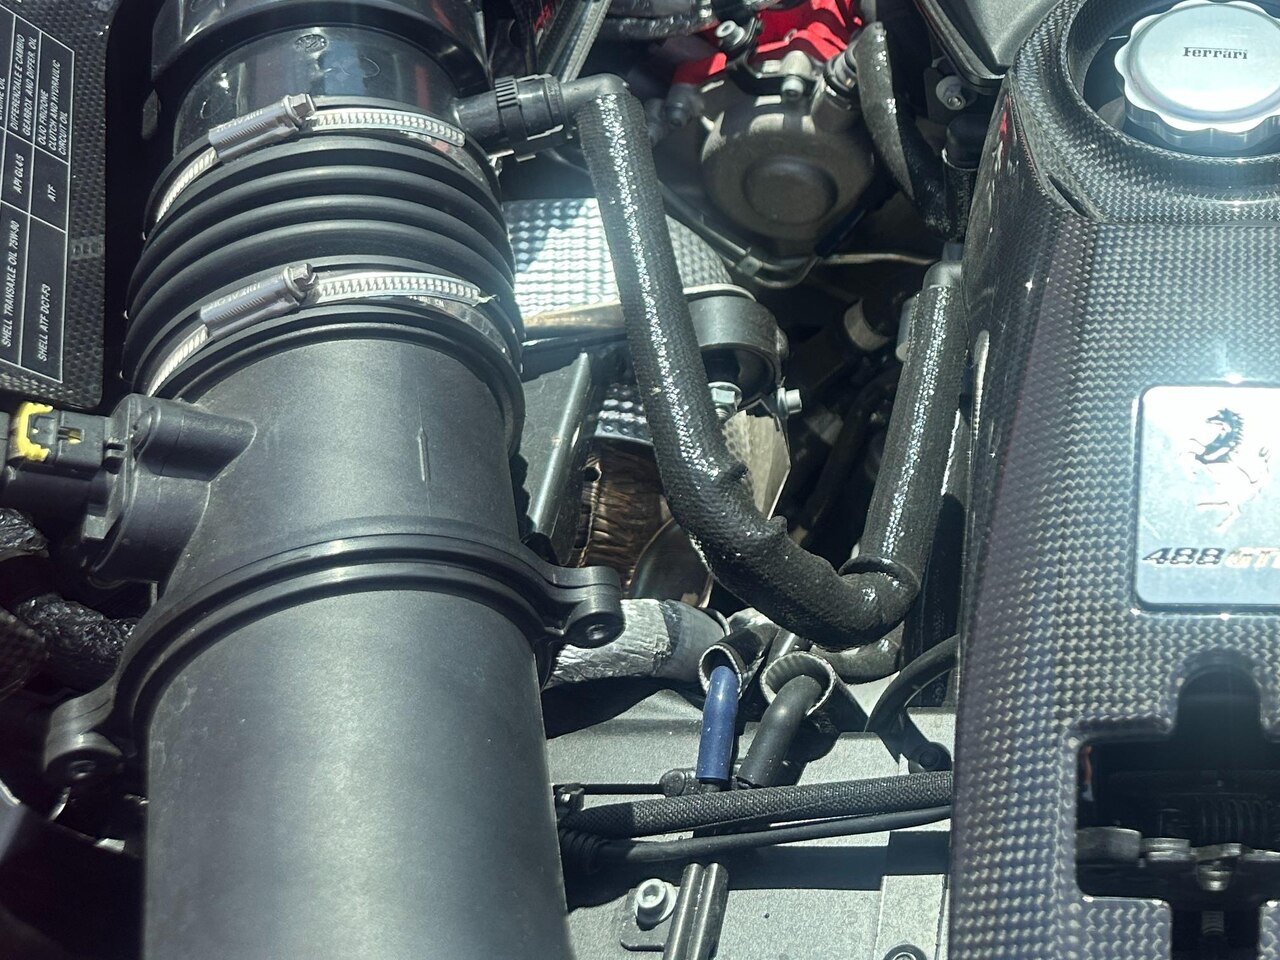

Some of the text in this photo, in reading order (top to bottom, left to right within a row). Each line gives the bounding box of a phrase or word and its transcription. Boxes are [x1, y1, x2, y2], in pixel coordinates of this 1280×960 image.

[15, 34, 24, 64] CAMBIO
[1182, 46, 1249, 60] Ferrari
[11, 73, 22, 130] DIFFERENZIALE
[23, 37, 36, 136] GEARBOX AND DIFFER. OIL
[52, 60, 60, 102] HYDRAULIC
[38, 90, 48, 145] OLIO FRIZIONE
[59, 111, 68, 155] CIRCUIT OIL
[13, 154, 24, 194] API GL4/5
[48, 184, 56, 202] ATF
[2, 220, 20, 347] SHELL TRANSAXLE OIL 75W-90
[38, 284, 50, 361] SHELL ATF DCT-F3
[1142, 547, 1226, 565] 488
